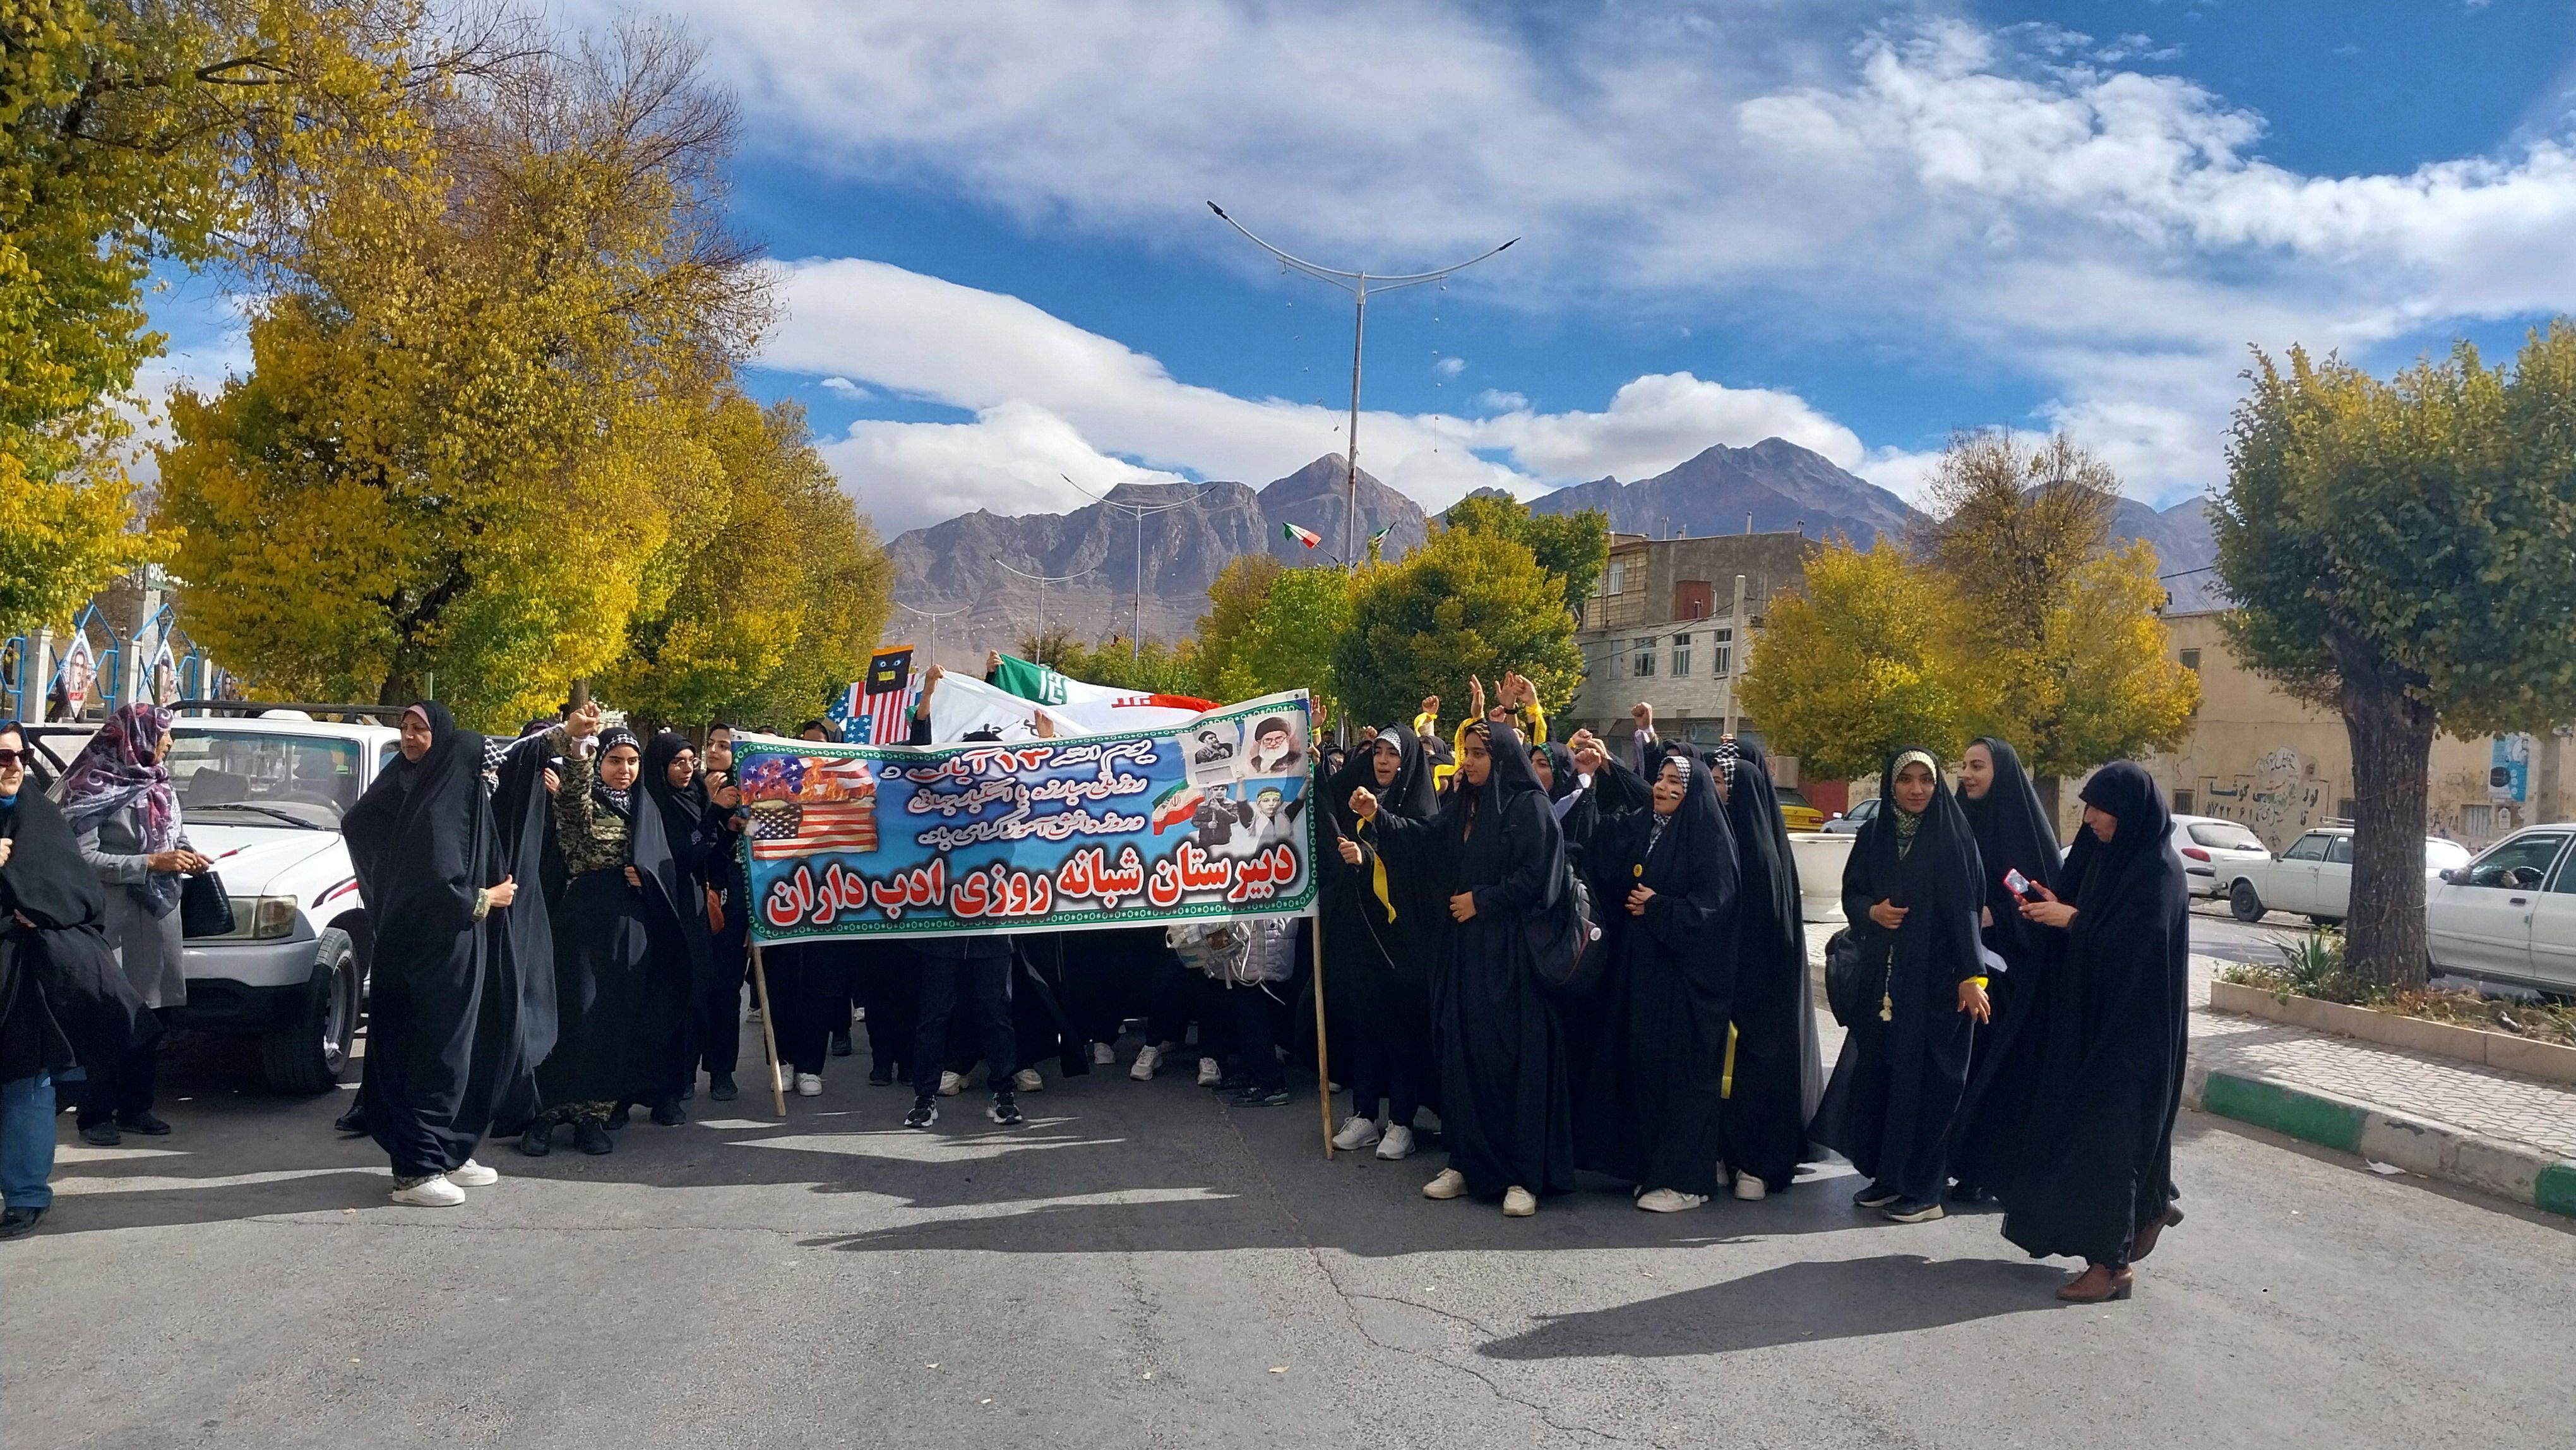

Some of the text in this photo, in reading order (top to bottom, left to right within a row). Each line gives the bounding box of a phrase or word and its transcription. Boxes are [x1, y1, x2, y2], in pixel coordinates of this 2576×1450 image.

[880, 740, 1157, 784] یوم الله ۱۳ آبان و
[956, 777, 1016, 813] استکبار
[1015, 784, 1030, 809] با
[1031, 779, 1090, 806] مبارزه
[1112, 774, 1147, 794] روز
[908, 789, 958, 816] جهانی
[999, 815, 1059, 839] آموز
[1045, 810, 1100, 840] دانش
[767, 841, 1296, 926] دبیرستان شبانه روزی ادب داران
